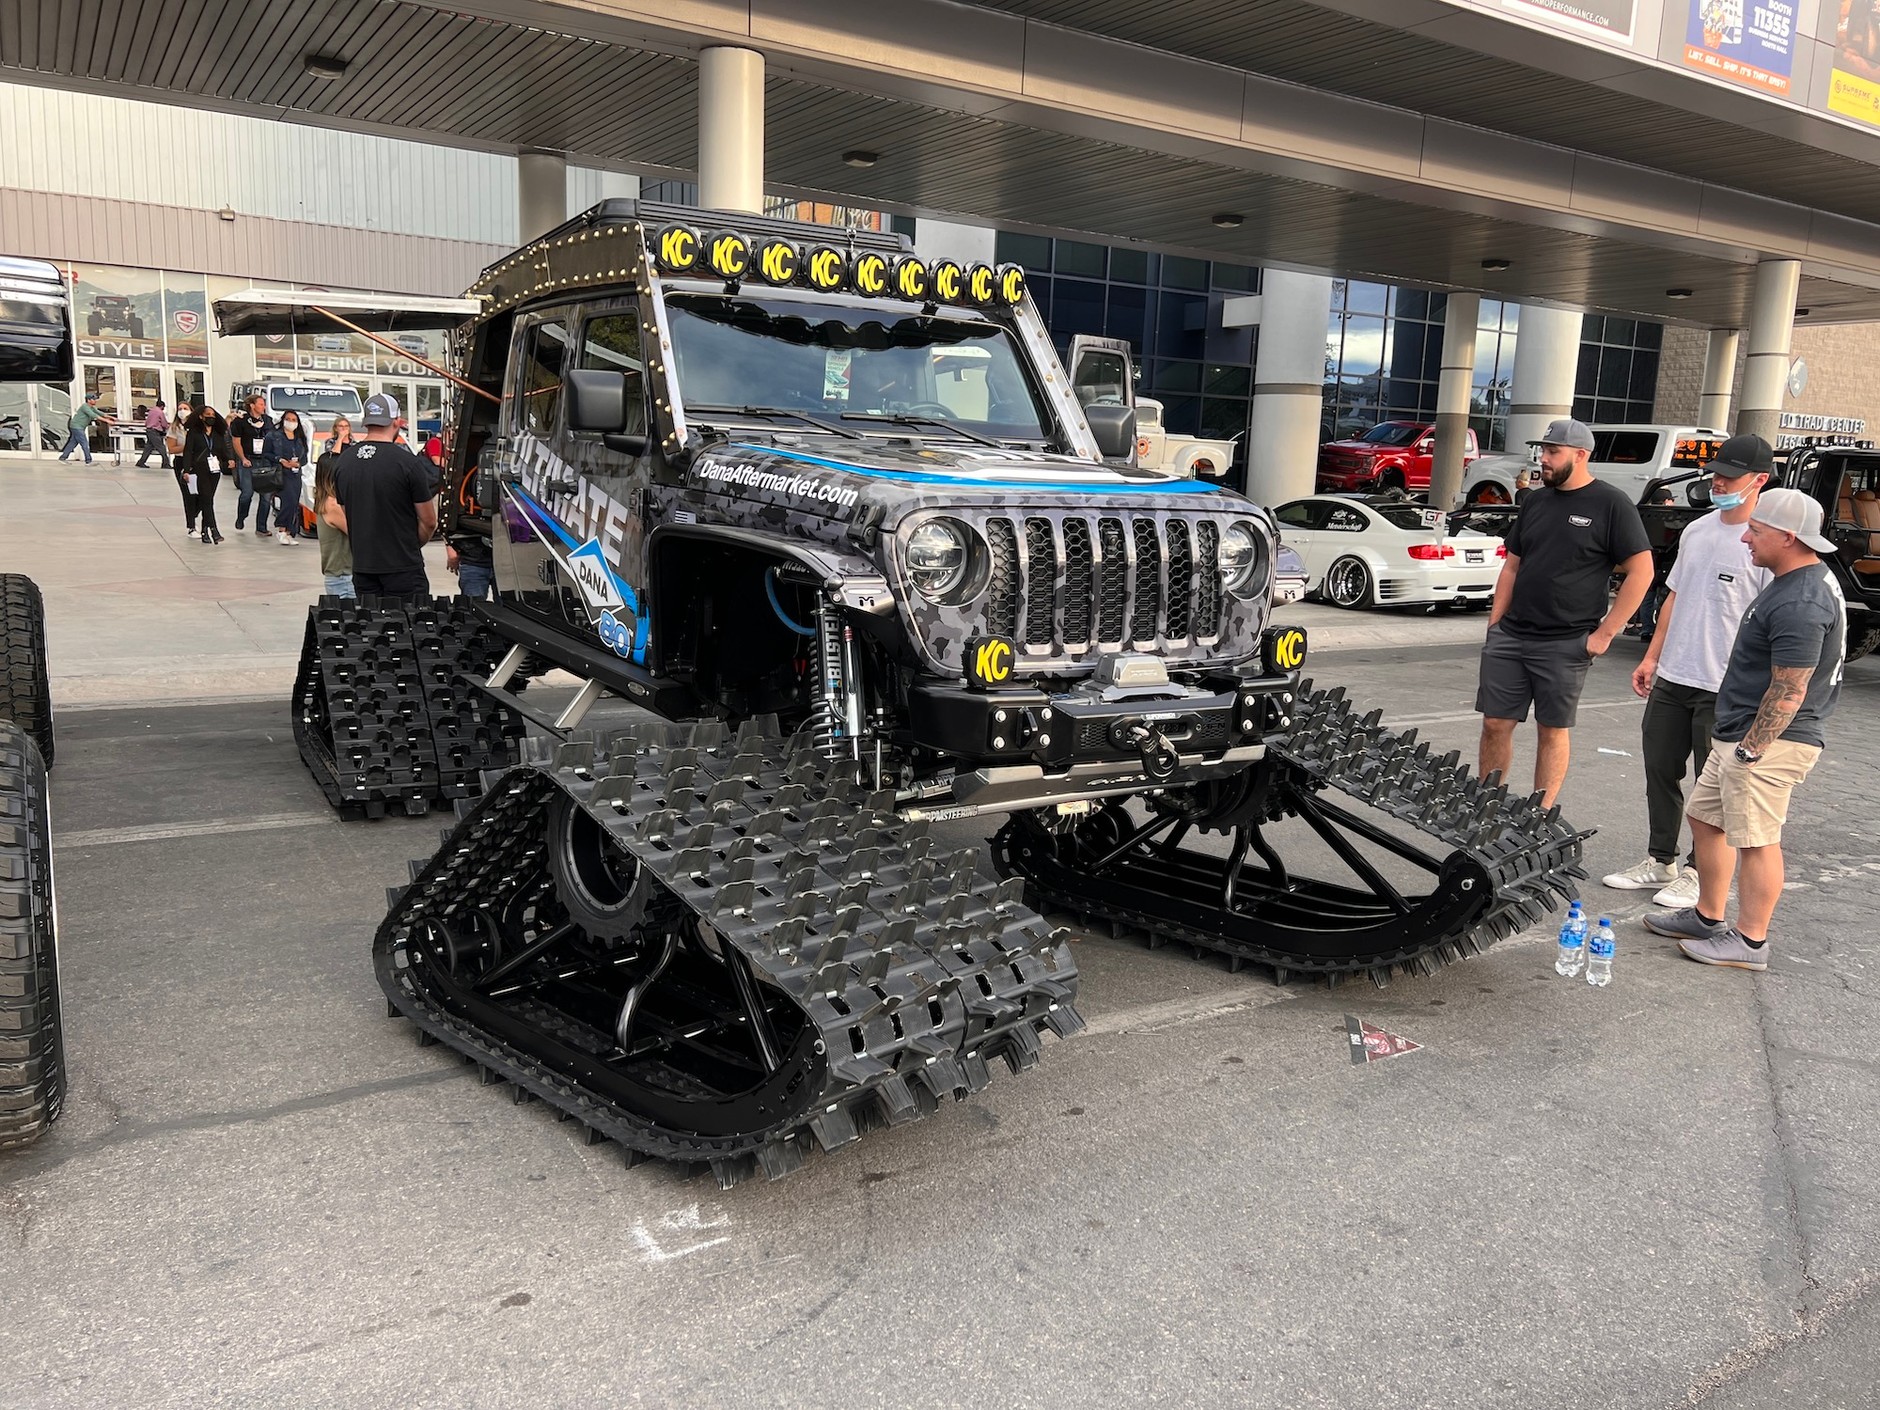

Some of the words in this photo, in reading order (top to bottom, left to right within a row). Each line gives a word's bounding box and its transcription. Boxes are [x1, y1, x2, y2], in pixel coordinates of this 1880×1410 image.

[1754, 6, 1790, 37] 11355
[1768, 0, 1792, 16] BOOTH
[1776, 45, 1788, 55] HALL
[1740, 66, 1752, 77] IT'S
[1753, 70, 1768, 82] THAT
[1768, 75, 1786, 89] EASY!
[663, 230, 693, 267] KC
[713, 237, 744, 274] KC
[764, 244, 792, 280] KC
[812, 251, 840, 286] KC
[859, 256, 884, 291] KC
[900, 261, 924, 295] KC
[937, 264, 959, 299] KC
[972, 267, 993, 301] KC
[1003, 269, 1022, 303] KC
[79, 340, 155, 358] STYLE
[299, 353, 374, 372] DEFINE
[296, 389, 343, 397] SPYDER
[1828, 418, 1866, 433] CENTER
[510, 431, 628, 567] ULTIMATE
[700, 459, 859, 507] DanaAftermarket.com
[1425, 511, 1443, 521] GT
[579, 560, 609, 601] DANA
[599, 608, 630, 658] 80
[823, 601, 842, 680] BILSTEIN
[1276, 631, 1304, 668] KC
[975, 639, 1011, 682] KC
